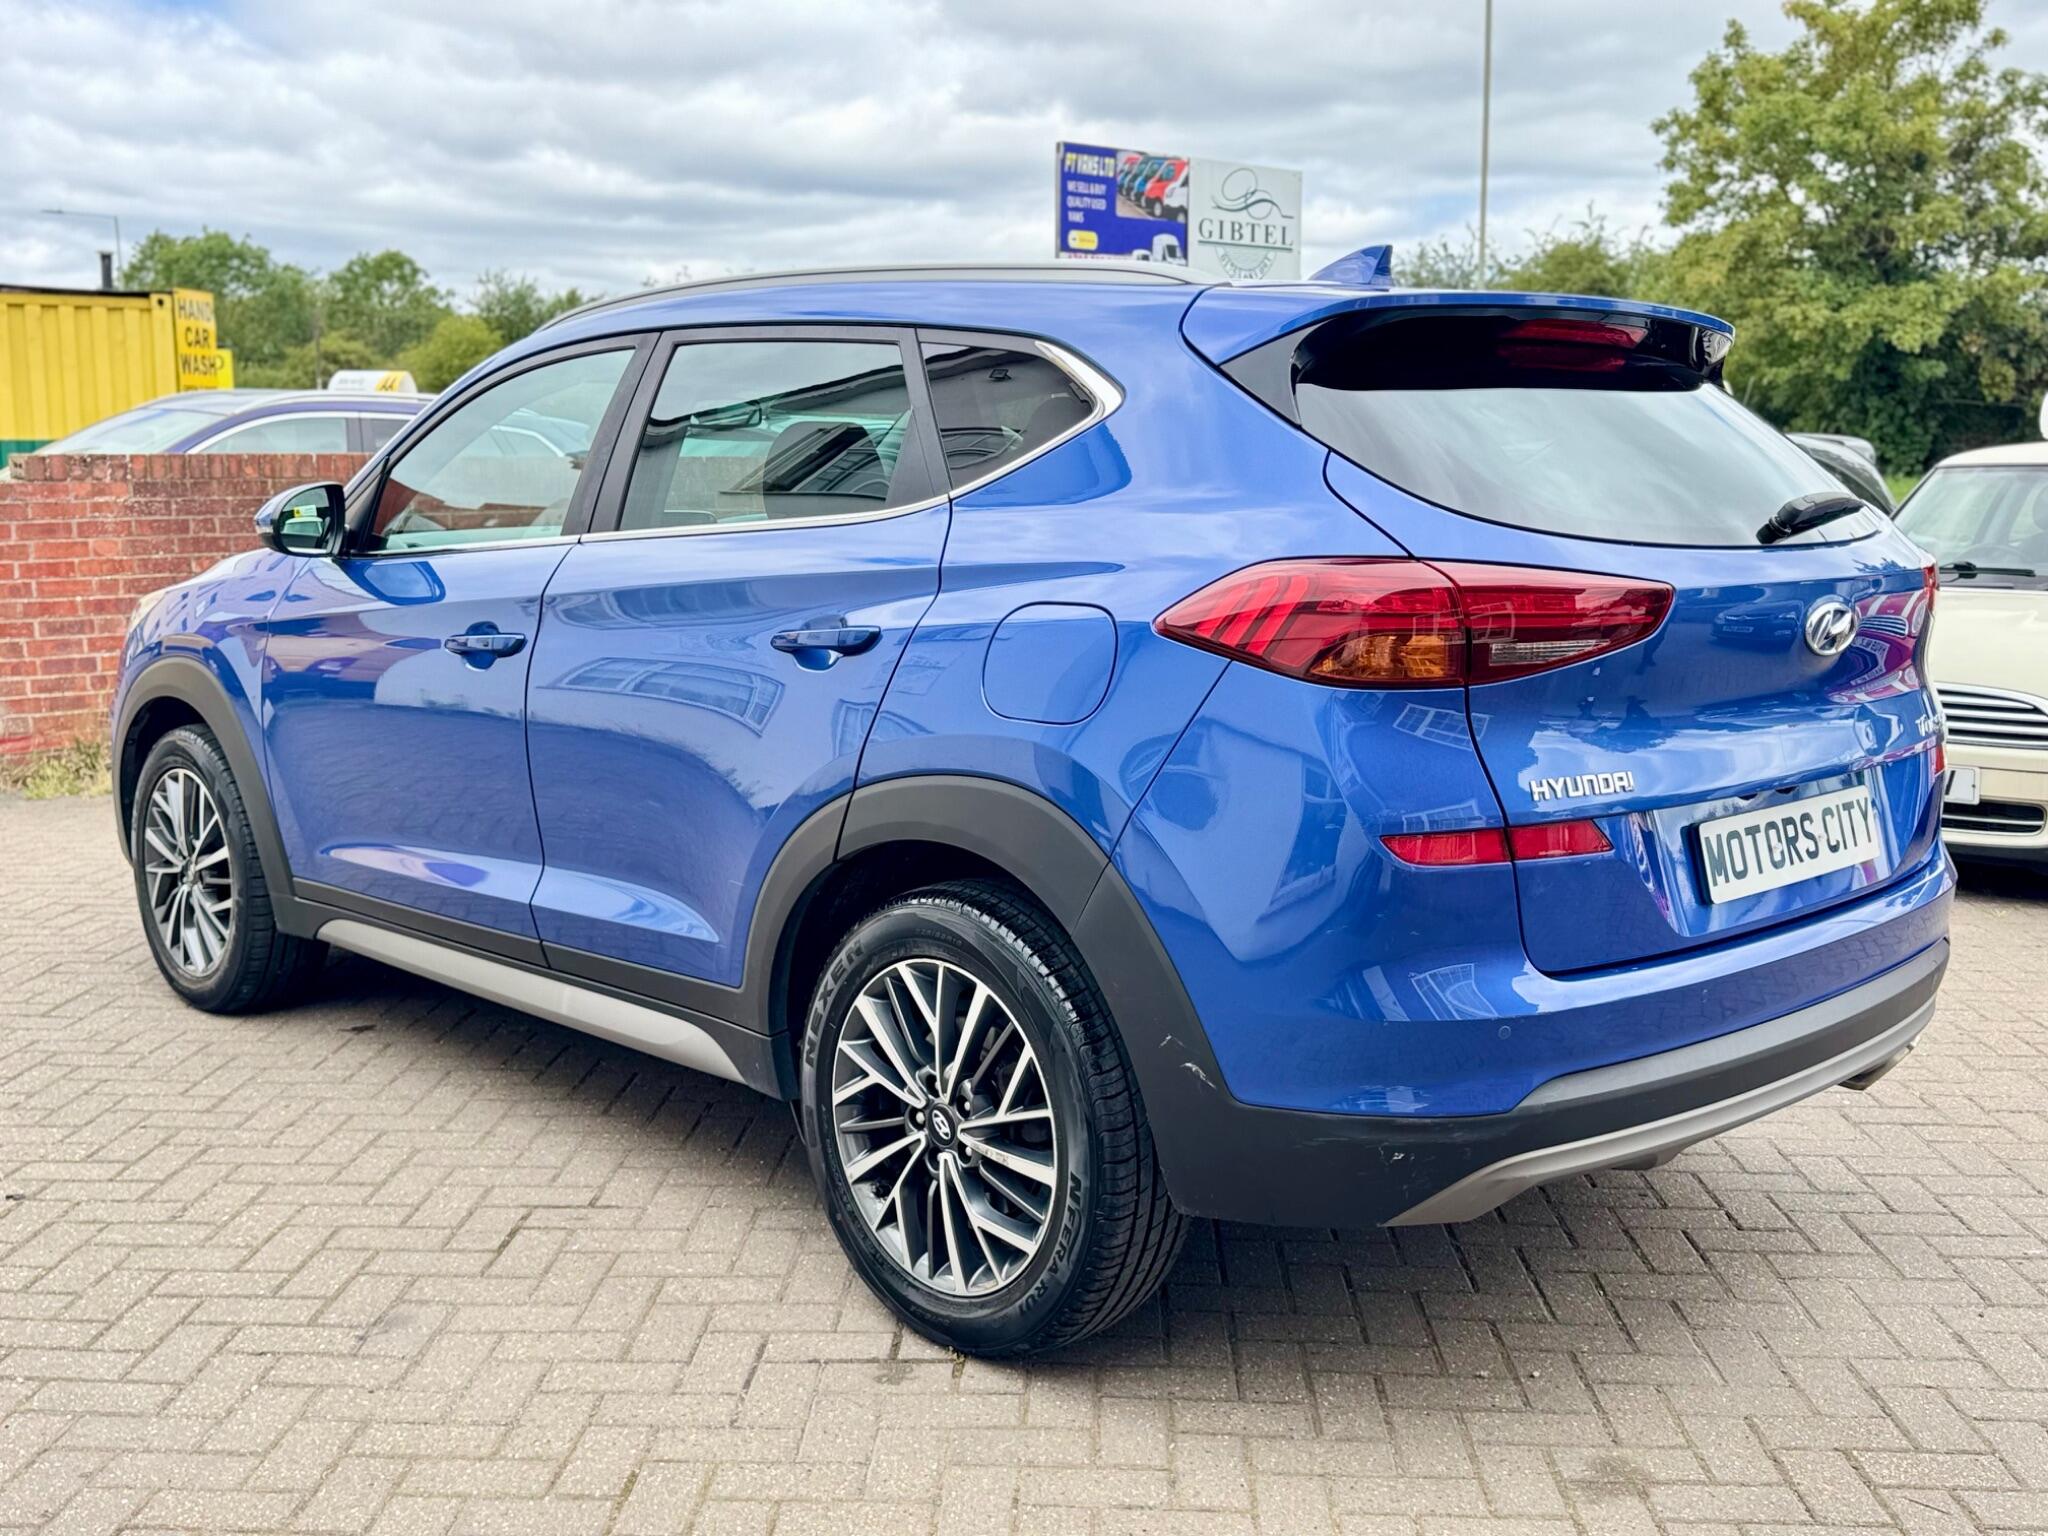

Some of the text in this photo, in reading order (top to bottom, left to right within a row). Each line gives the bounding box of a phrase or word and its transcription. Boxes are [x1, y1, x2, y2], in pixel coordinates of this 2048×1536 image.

[1077, 154, 1098, 176] VANS
[1099, 156, 1115, 177] LTD
[1198, 217, 1293, 247] GIBTEL
[178, 298, 215, 323] HAND
[184, 326, 210, 349] CAR
[180, 353, 217, 376] WASH
[1529, 771, 1634, 801] HYUNDAI
[1704, 797, 1872, 887] MOTORS CITY
[805, 939, 863, 1068] NEXEN
